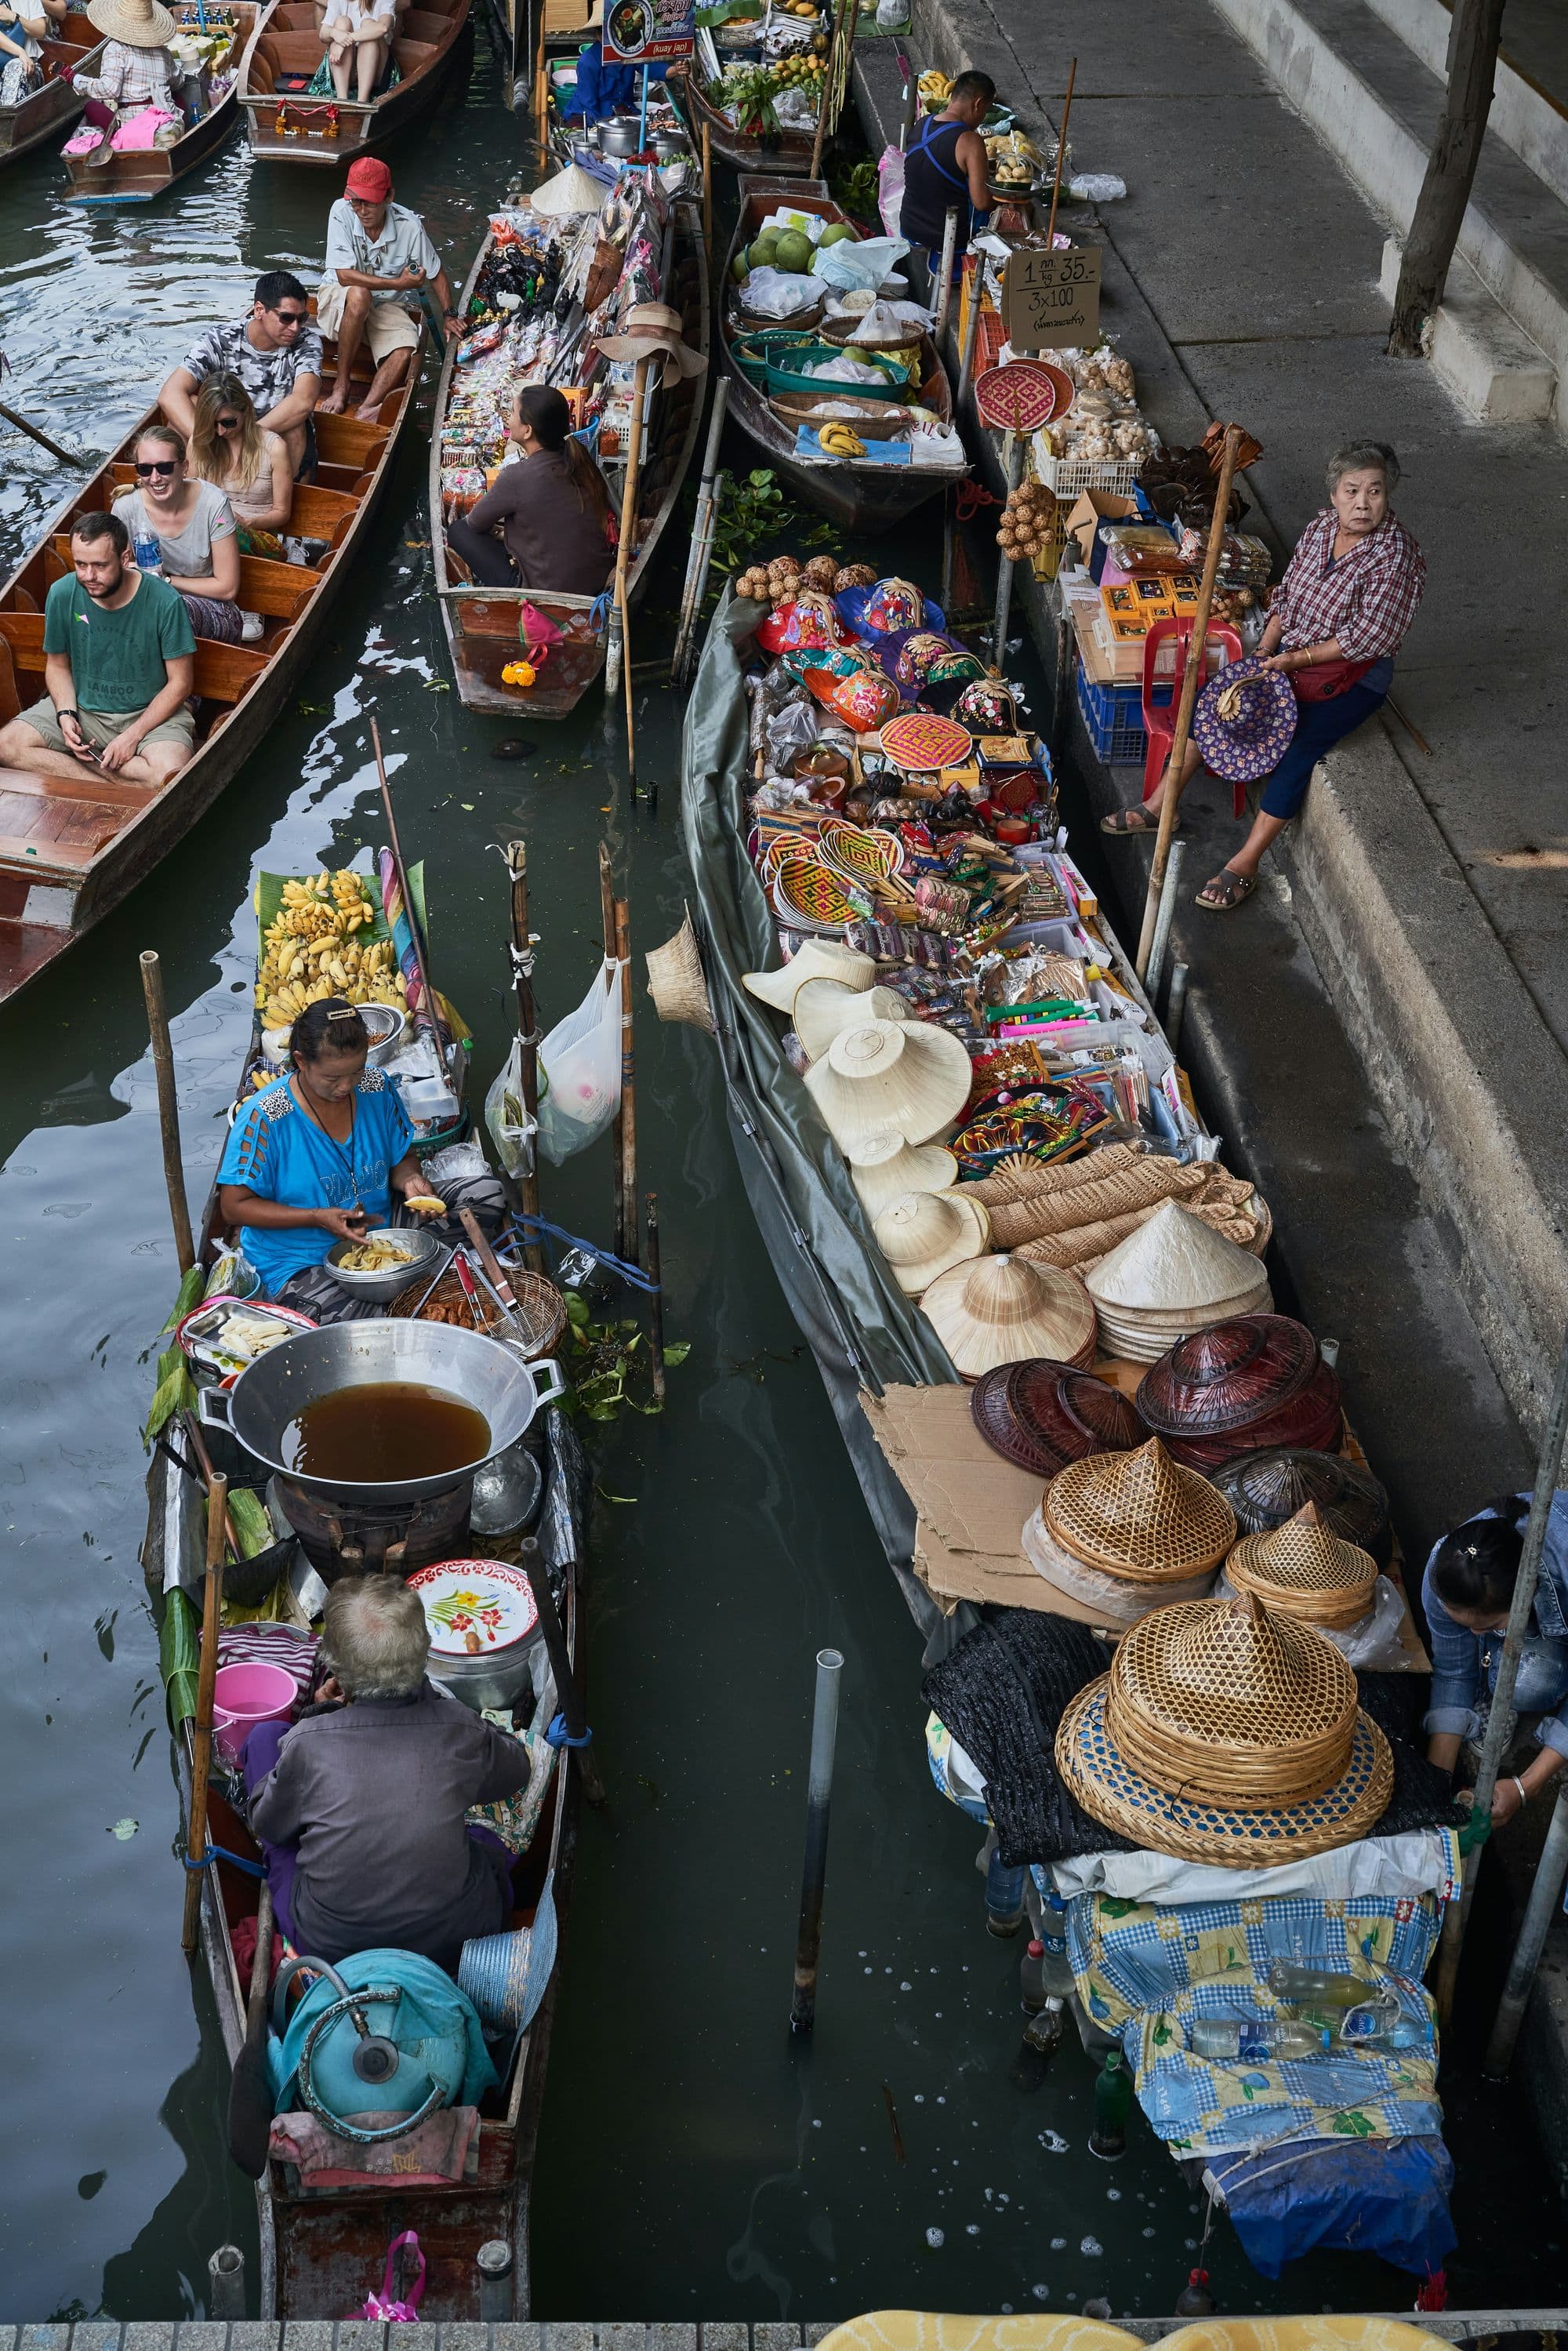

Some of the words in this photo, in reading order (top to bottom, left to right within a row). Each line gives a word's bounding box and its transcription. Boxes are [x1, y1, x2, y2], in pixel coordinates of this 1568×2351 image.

[653, 44, 672, 55] (kuay
[673, 42, 687, 53] jap)
[1025, 261, 1036, 283] 1
[1042, 273, 1053, 287] kg
[87, 683, 134, 696] BAMBOO
[1156, 2087, 1171, 2117] APPLE
[383, 2158, 393, 2174] Star
